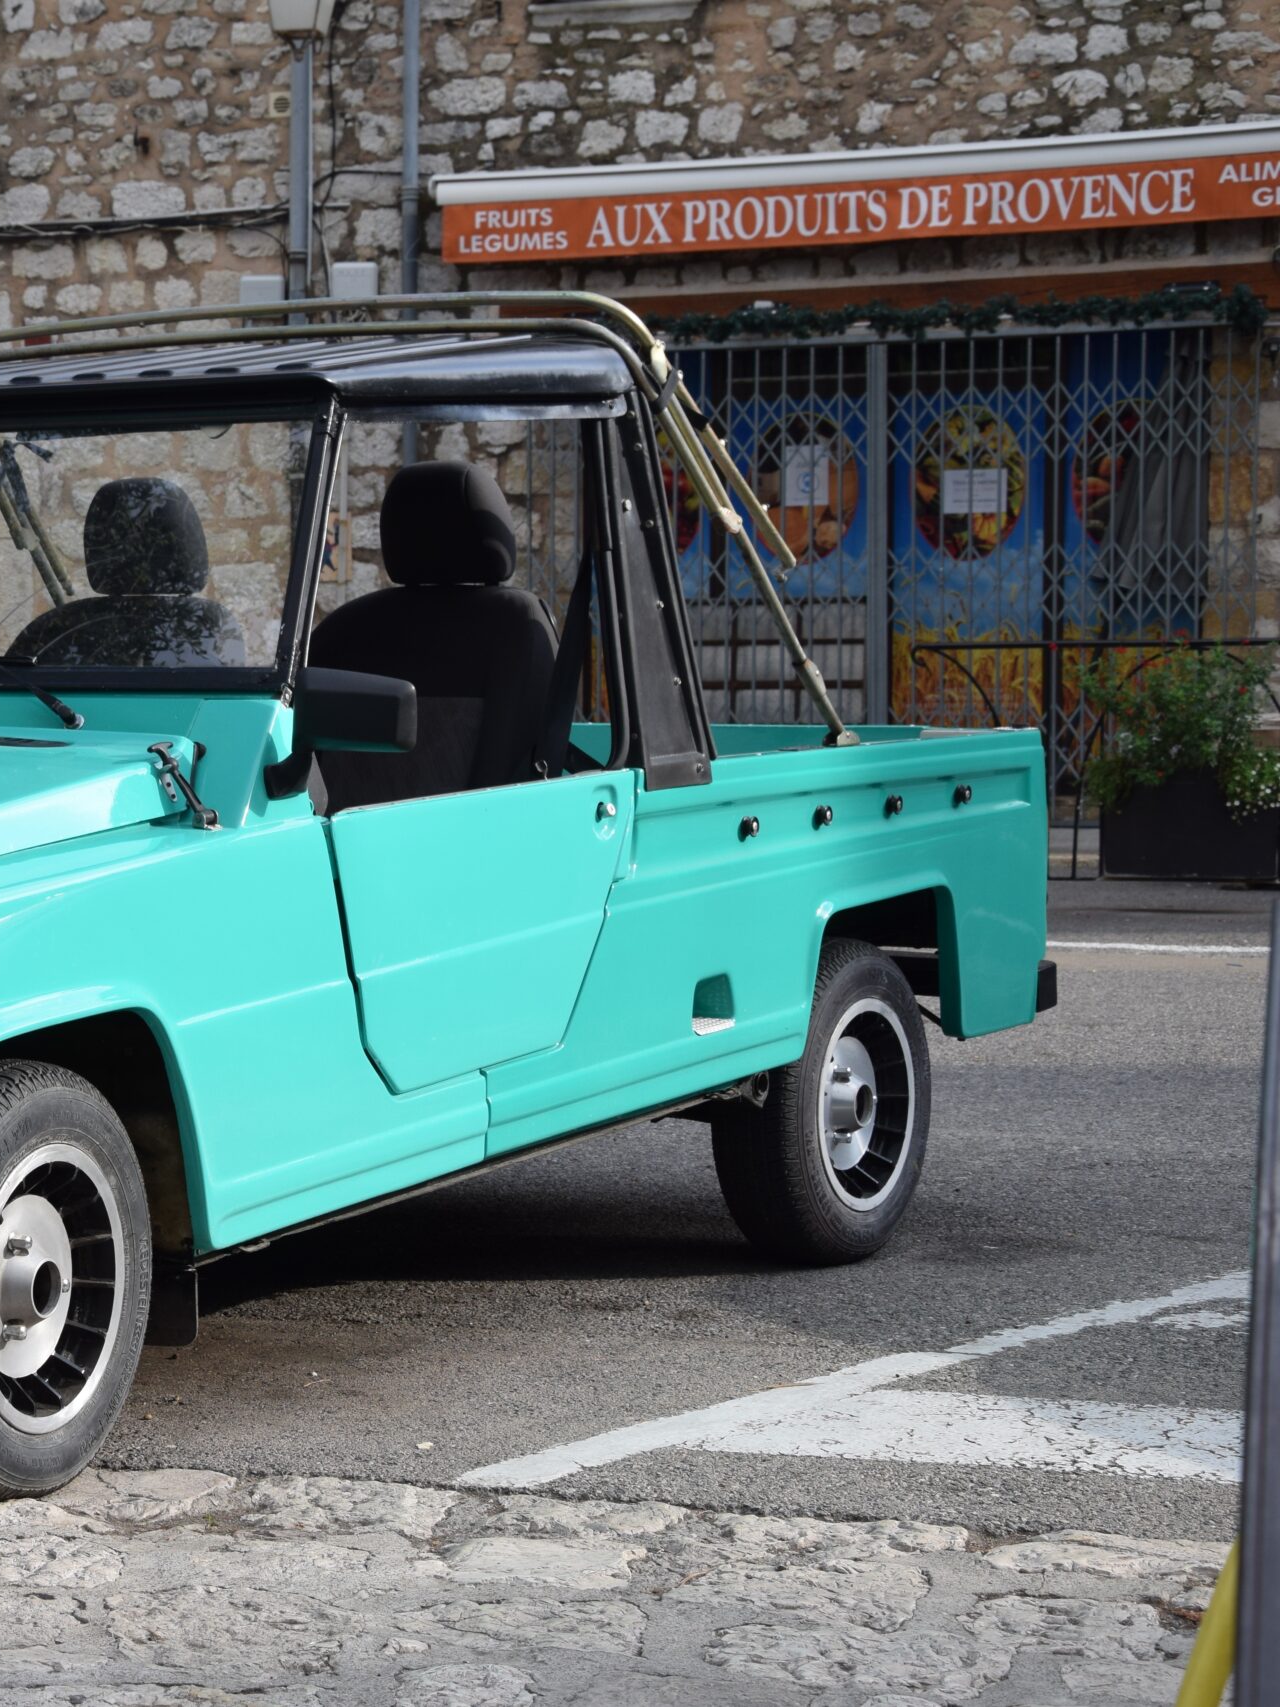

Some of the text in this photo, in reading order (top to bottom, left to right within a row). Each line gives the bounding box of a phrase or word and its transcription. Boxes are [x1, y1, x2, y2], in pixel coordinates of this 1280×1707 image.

[475, 208, 552, 229] FRUITS
[586, 168, 1195, 248] AUX PRODUITS DE PROVENCE
[459, 231, 568, 253] LEGUMES
